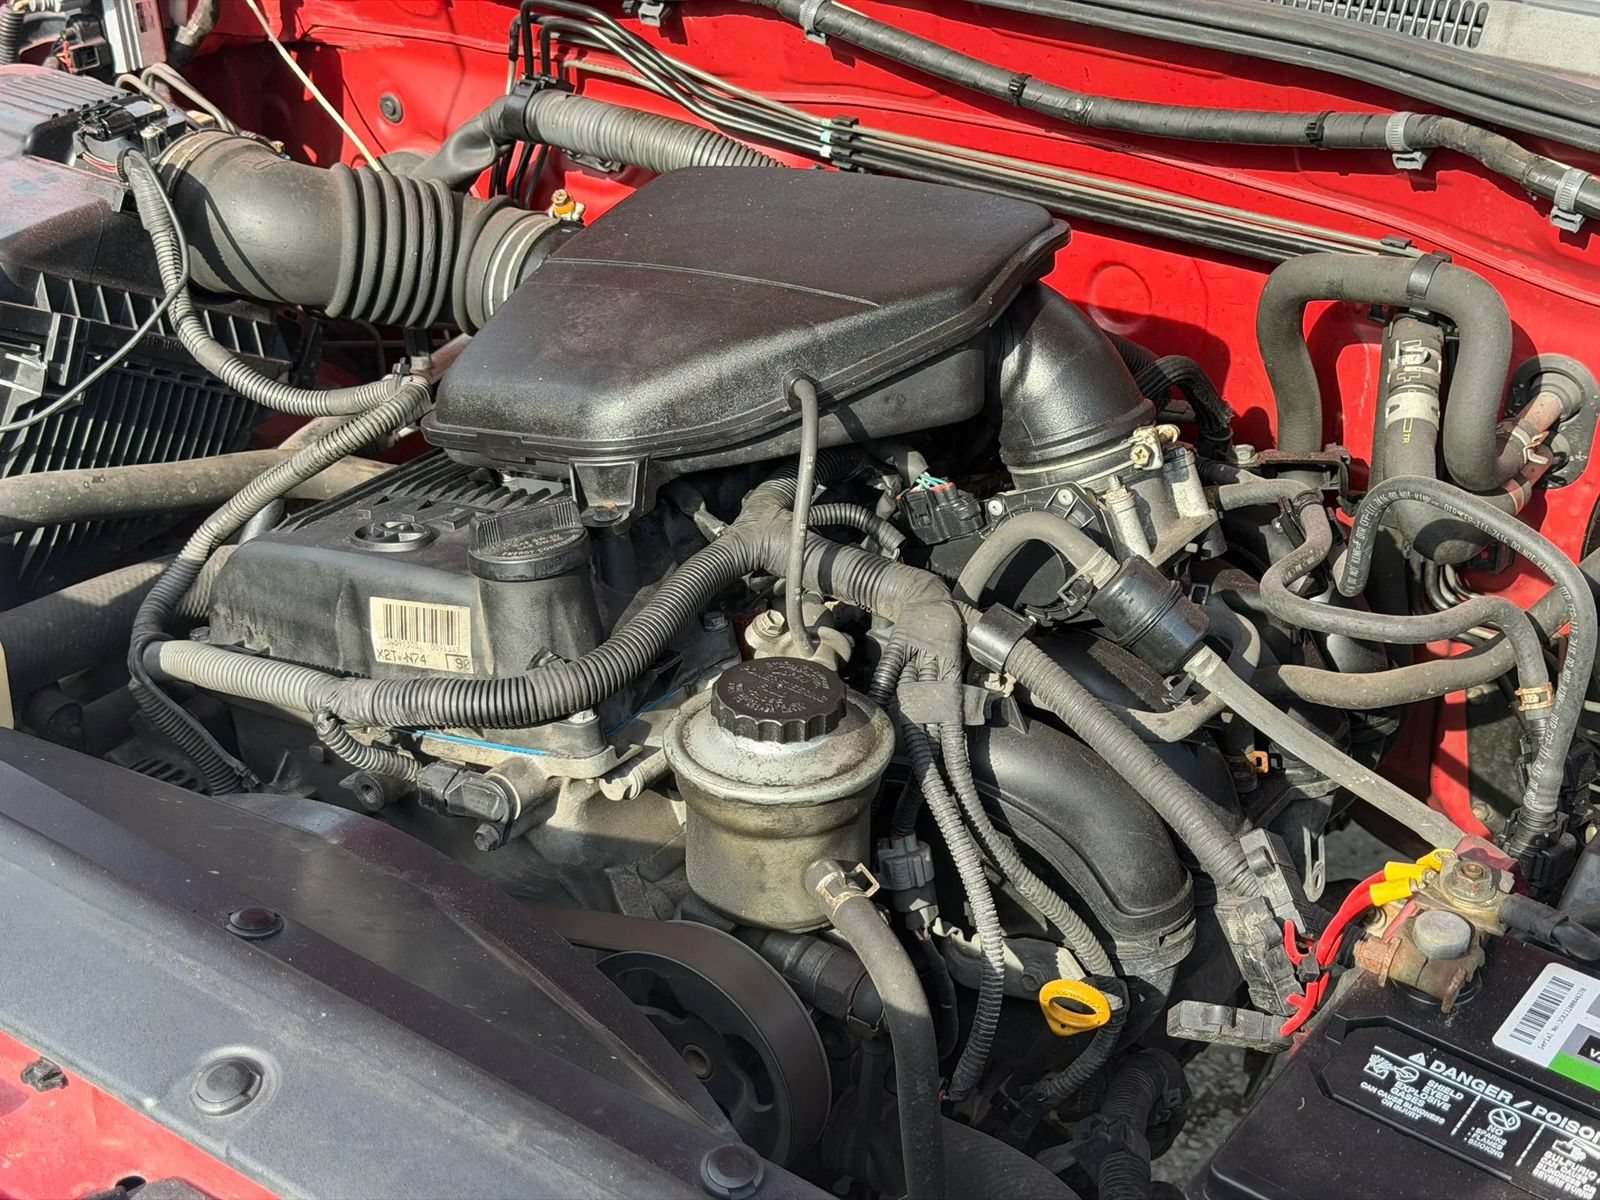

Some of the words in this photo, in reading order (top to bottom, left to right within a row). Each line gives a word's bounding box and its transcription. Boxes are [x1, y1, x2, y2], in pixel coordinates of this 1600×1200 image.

[1427, 1080, 1464, 1100] SHIELD
[1430, 1060, 1513, 1104] DANGER
[1361, 1082, 1378, 1093] CAN
[1377, 1090, 1403, 1105] CAUSE
[1403, 1101, 1445, 1124] BLINDNESS
[1391, 1087, 1425, 1107] GASES
[1394, 1081, 1451, 1110] EXPLOSIVE
[1422, 1086, 1450, 1101] EYES
[1381, 1098, 1393, 1108] OR
[1393, 1104, 1421, 1119] INJURY
[1475, 1128, 1507, 1145] SPARKS
[1487, 1125, 1503, 1136] NO
[1468, 1138, 1504, 1159] SMOKING
[1472, 1133, 1503, 1150] FLAMES
[1540, 1157, 1559, 1170] CAN
[1559, 1165, 1589, 1185] CAUSE
[1544, 1151, 1597, 1180] SULFURIC
[1536, 1162, 1581, 1188] BLINDNESS
[1582, 1182, 1596, 1195] OR
